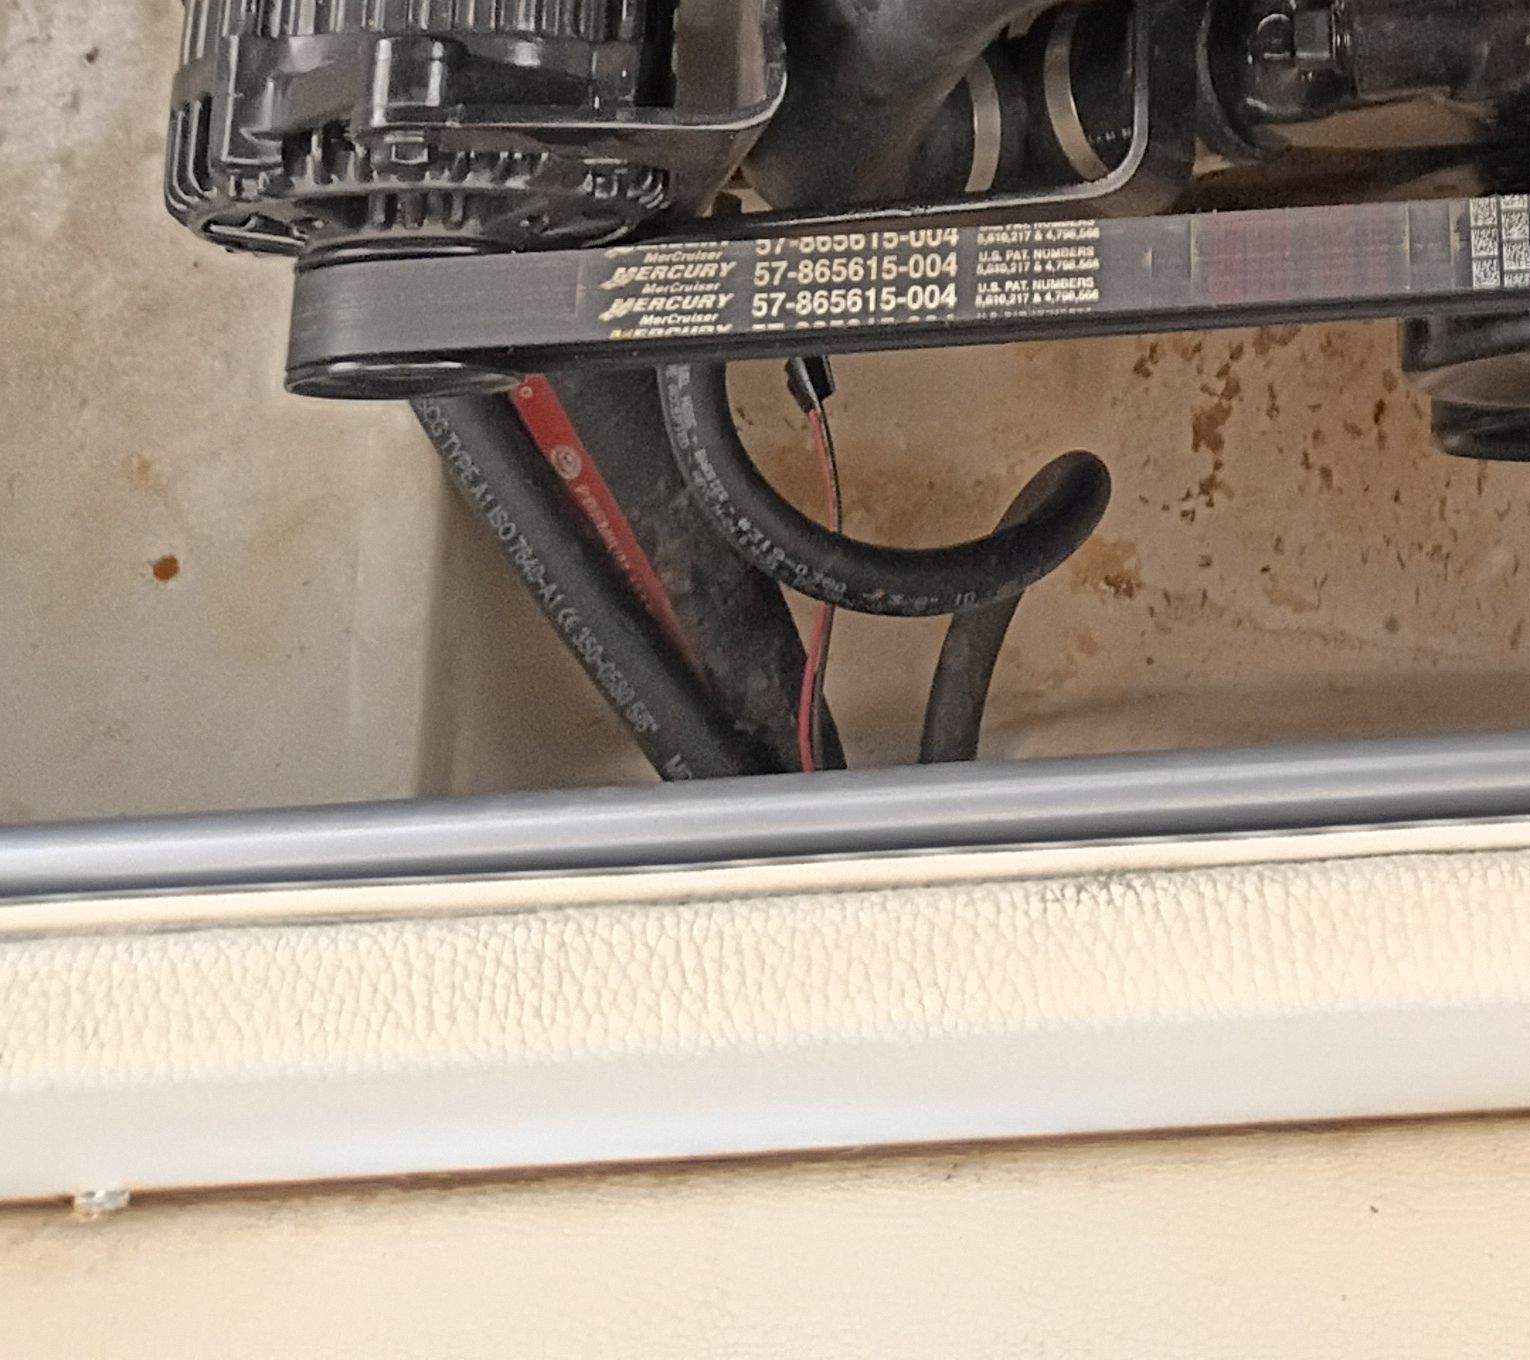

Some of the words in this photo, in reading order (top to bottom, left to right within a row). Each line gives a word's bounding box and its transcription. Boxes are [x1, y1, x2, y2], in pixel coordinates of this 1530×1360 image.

[643, 249, 724, 265] MerCruiser
[978, 250, 1002, 262] U.S.
[1005, 248, 1030, 260] PAT.
[1032, 245, 1094, 259] NUMBERS
[599, 261, 737, 291] MERCURY
[751, 252, 958, 286] 57-865615-004
[640, 279, 721, 295] MerCruiser
[977, 281, 1001, 293] U.S.
[1004, 279, 1029, 291] PAT.
[1031, 276, 1094, 290] NUMBERS
[597, 292, 735, 322] MERCURY
[750, 283, 957, 318] 57-865615-004
[638, 310, 719, 326] MerCruiser
[437, 430, 482, 484] TYPE
[484, 503, 519, 543] ISO
